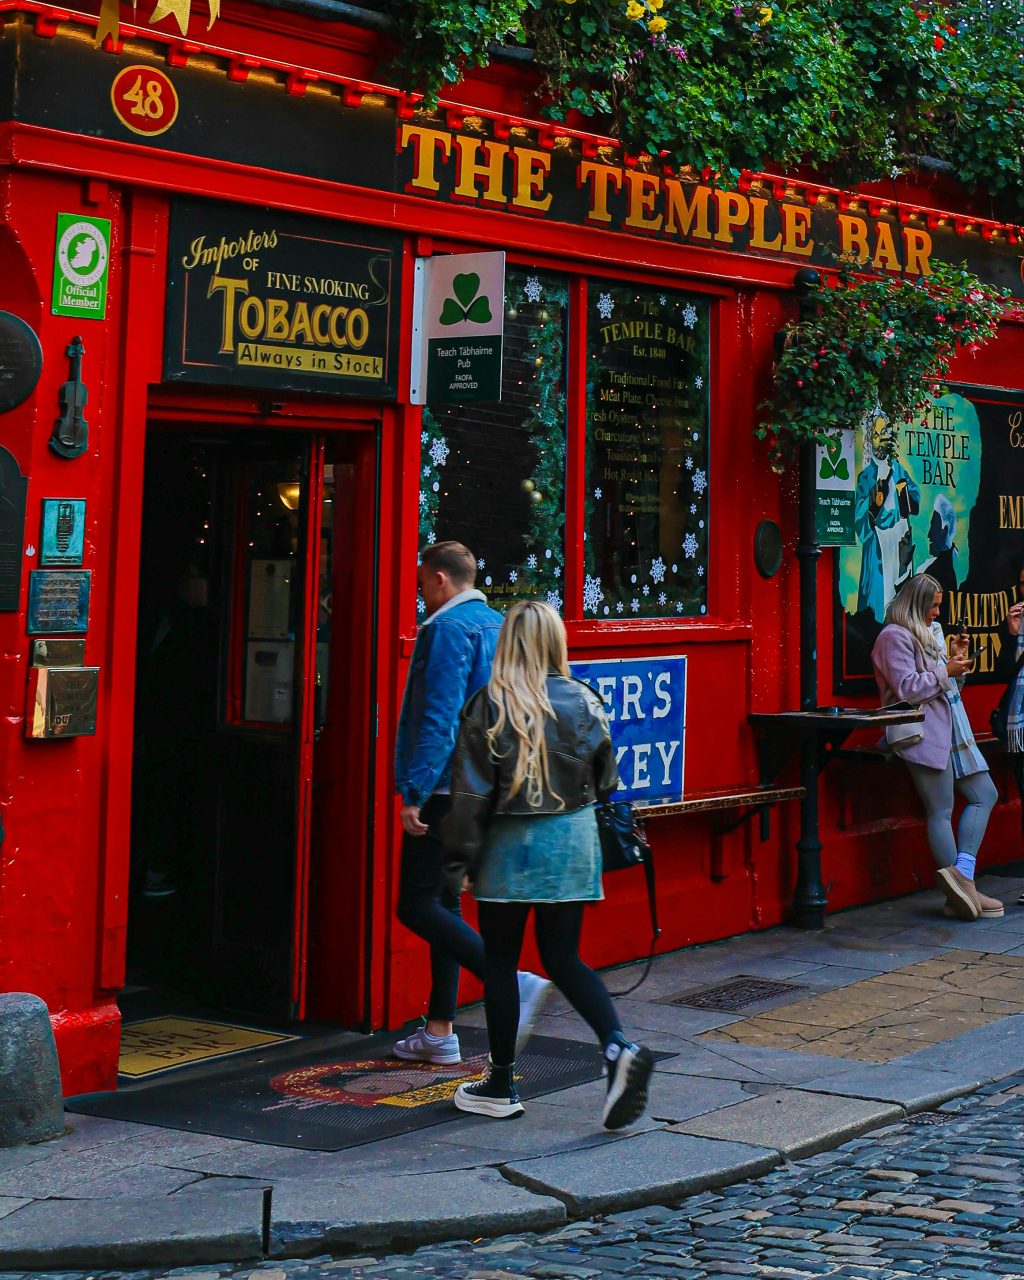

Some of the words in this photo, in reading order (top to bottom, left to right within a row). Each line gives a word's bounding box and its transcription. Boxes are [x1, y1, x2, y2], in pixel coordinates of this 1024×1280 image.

[123, 74, 164, 119] 48
[402, 123, 553, 212] THE
[581, 160, 815, 258] TEMPLE
[838, 213, 934, 277] BAR
[182, 228, 278, 275] Importers
[242, 257, 260, 272] OF
[66, 284, 98, 298] Official
[266, 271, 301, 292] FINE
[303, 276, 371, 301] SMOKING
[63, 295, 100, 308] Member
[206, 273, 370, 355] TOBACCO
[600, 321, 664, 345] TEMPLE
[666, 327, 697, 354] BAR
[239, 343, 303, 368] Always
[311, 352, 327, 370] in
[332, 354, 380, 376] Stock
[436, 347, 458, 357] Teach
[459, 346, 493, 357] Tábhairne
[457, 358, 472, 369] Pub
[633, 345, 648, 357] Est.
[649, 347, 667, 359] 1840
[448, 381, 479, 390] APPROVED
[608, 370, 651, 387] Traditional
[652, 375, 671, 388] Food
[600, 388, 621, 403] Meat
[905, 430, 971, 461] TEMPLE
[921, 459, 957, 489] BAR
[818, 497, 832, 506] Teach
[830, 507, 840, 516] Pub
[948, 590, 1009, 628] MALTED
[580, 672, 672, 721] ER'S
